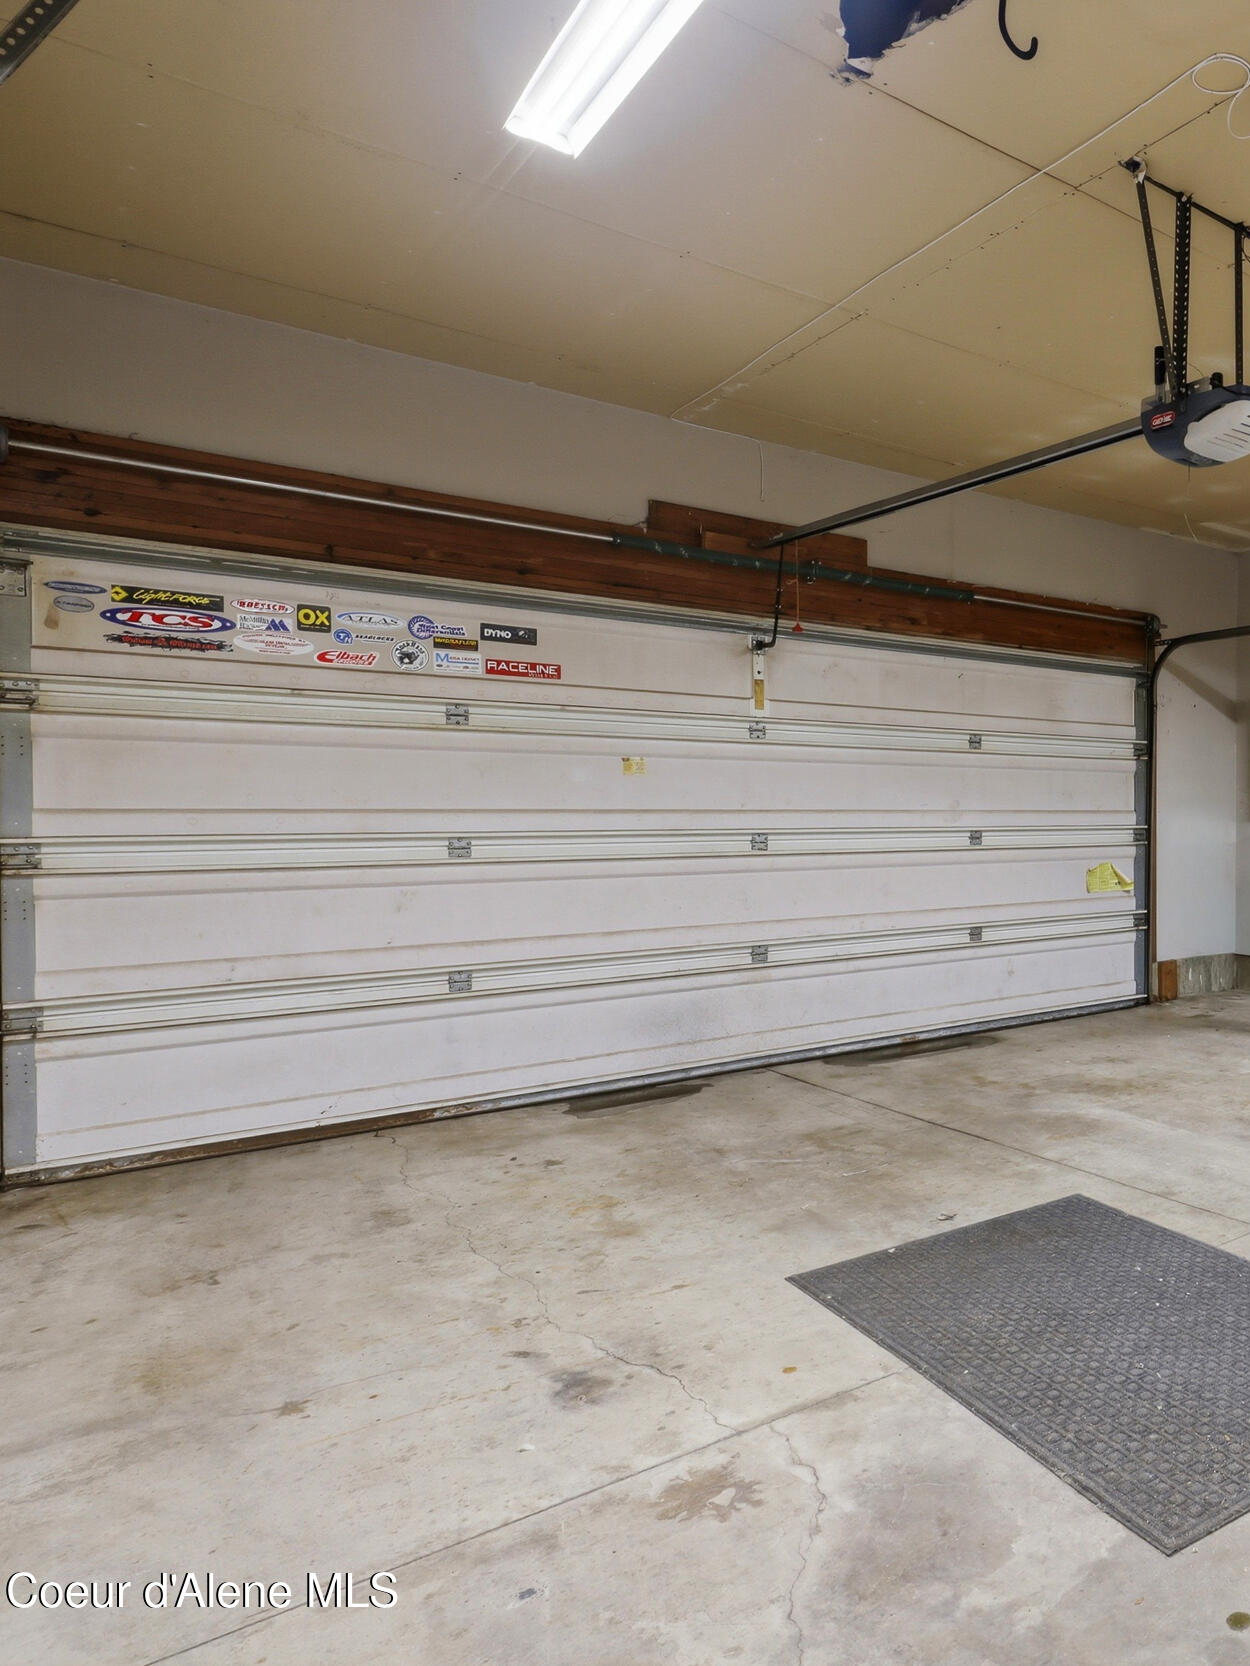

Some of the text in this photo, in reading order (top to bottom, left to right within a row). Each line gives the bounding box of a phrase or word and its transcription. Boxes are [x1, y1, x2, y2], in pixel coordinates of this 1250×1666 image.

[121, 608, 216, 629] TCS
[298, 608, 330, 626] OX
[483, 628, 512, 639] DYNO
[486, 660, 559, 675] RACELINE
